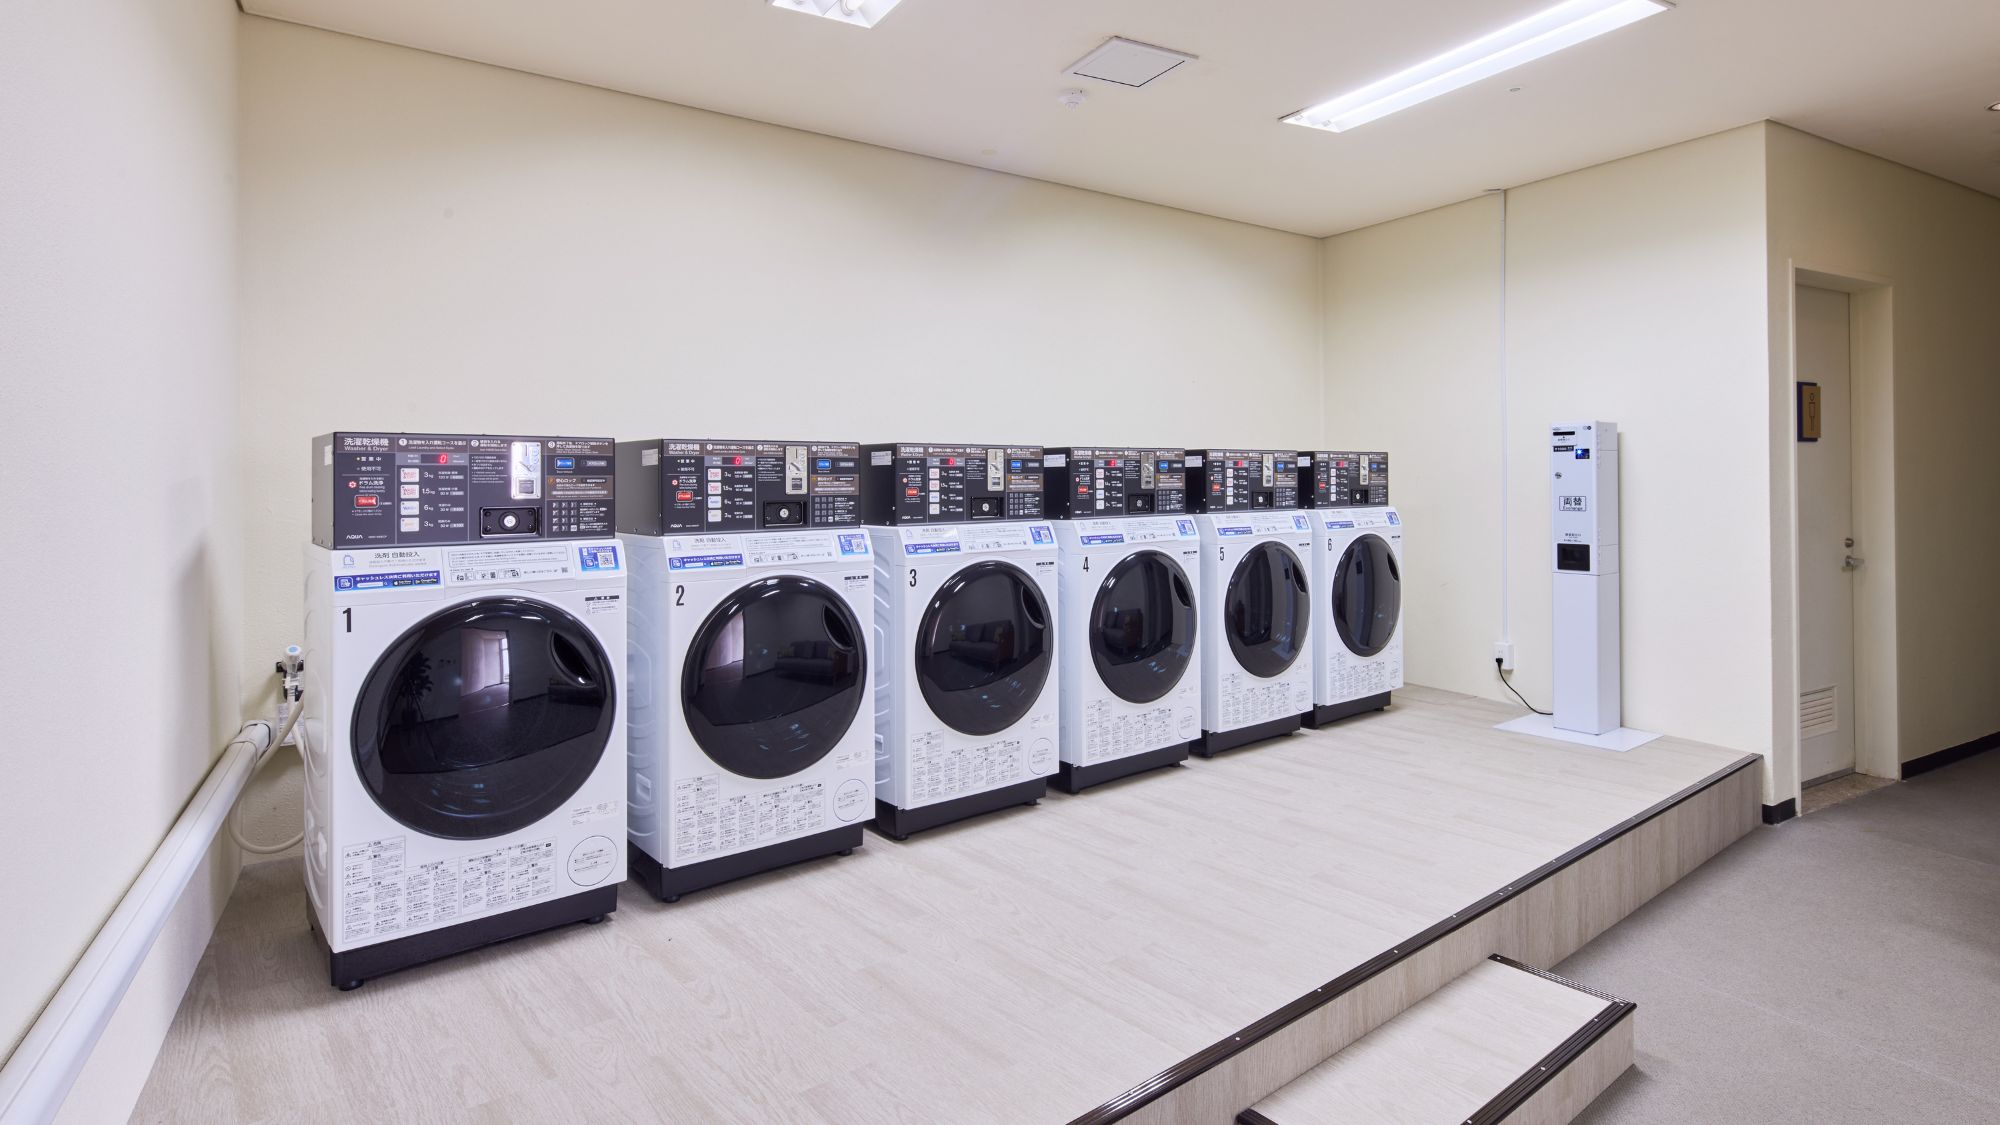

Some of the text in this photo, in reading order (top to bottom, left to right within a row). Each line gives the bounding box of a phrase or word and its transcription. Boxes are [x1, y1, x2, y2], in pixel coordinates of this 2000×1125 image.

[440, 454, 447, 462] 0
[1564, 497, 1582, 506] 両替
[1328, 538, 1332, 551] 6
[1220, 547, 1224, 560] 5
[1083, 557, 1089, 572] 4
[910, 569, 916, 587] 3
[676, 585, 684, 606] 2
[343, 608, 351, 632] 1
